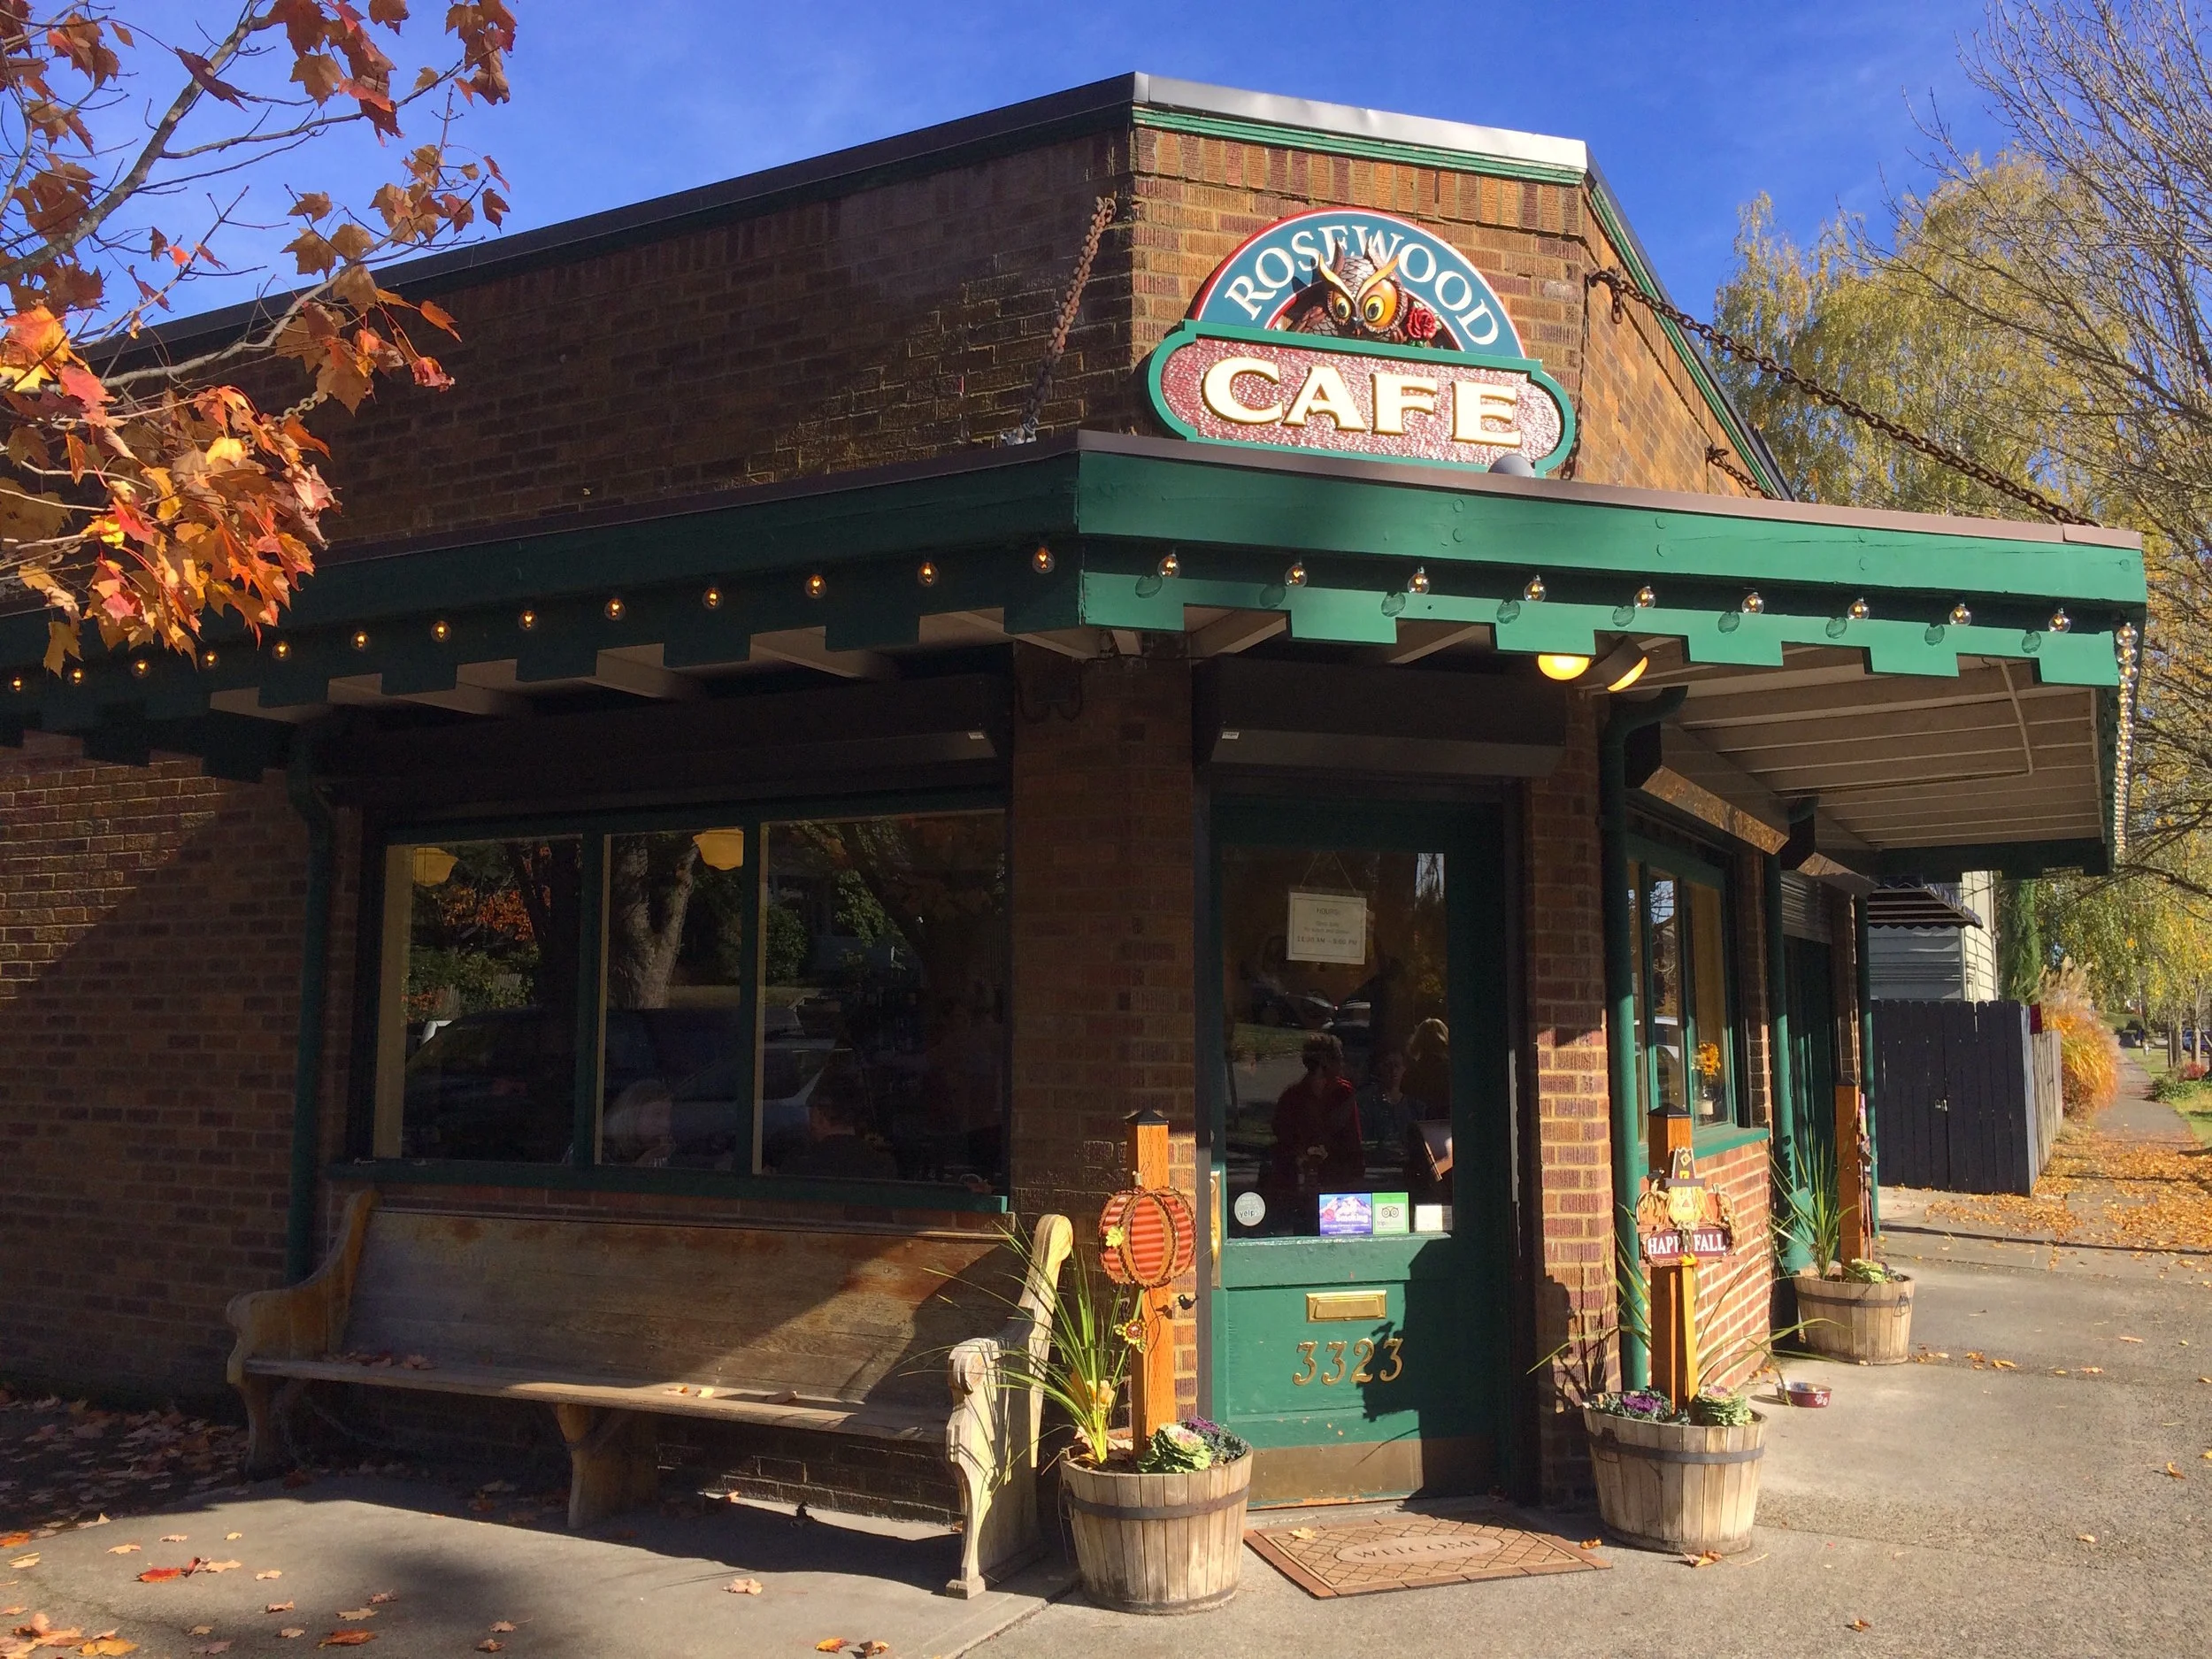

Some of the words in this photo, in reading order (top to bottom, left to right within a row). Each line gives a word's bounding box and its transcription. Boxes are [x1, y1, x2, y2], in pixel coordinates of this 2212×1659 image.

[1225, 224, 1499, 346] ROSEWOOD
[1202, 356, 1522, 448] CAFE
[1239, 1210, 1255, 1218] yelp
[1647, 1235, 1689, 1255] HAPP
[1693, 1233, 1726, 1252] FALL
[1292, 1337, 1403, 1386] 3323
